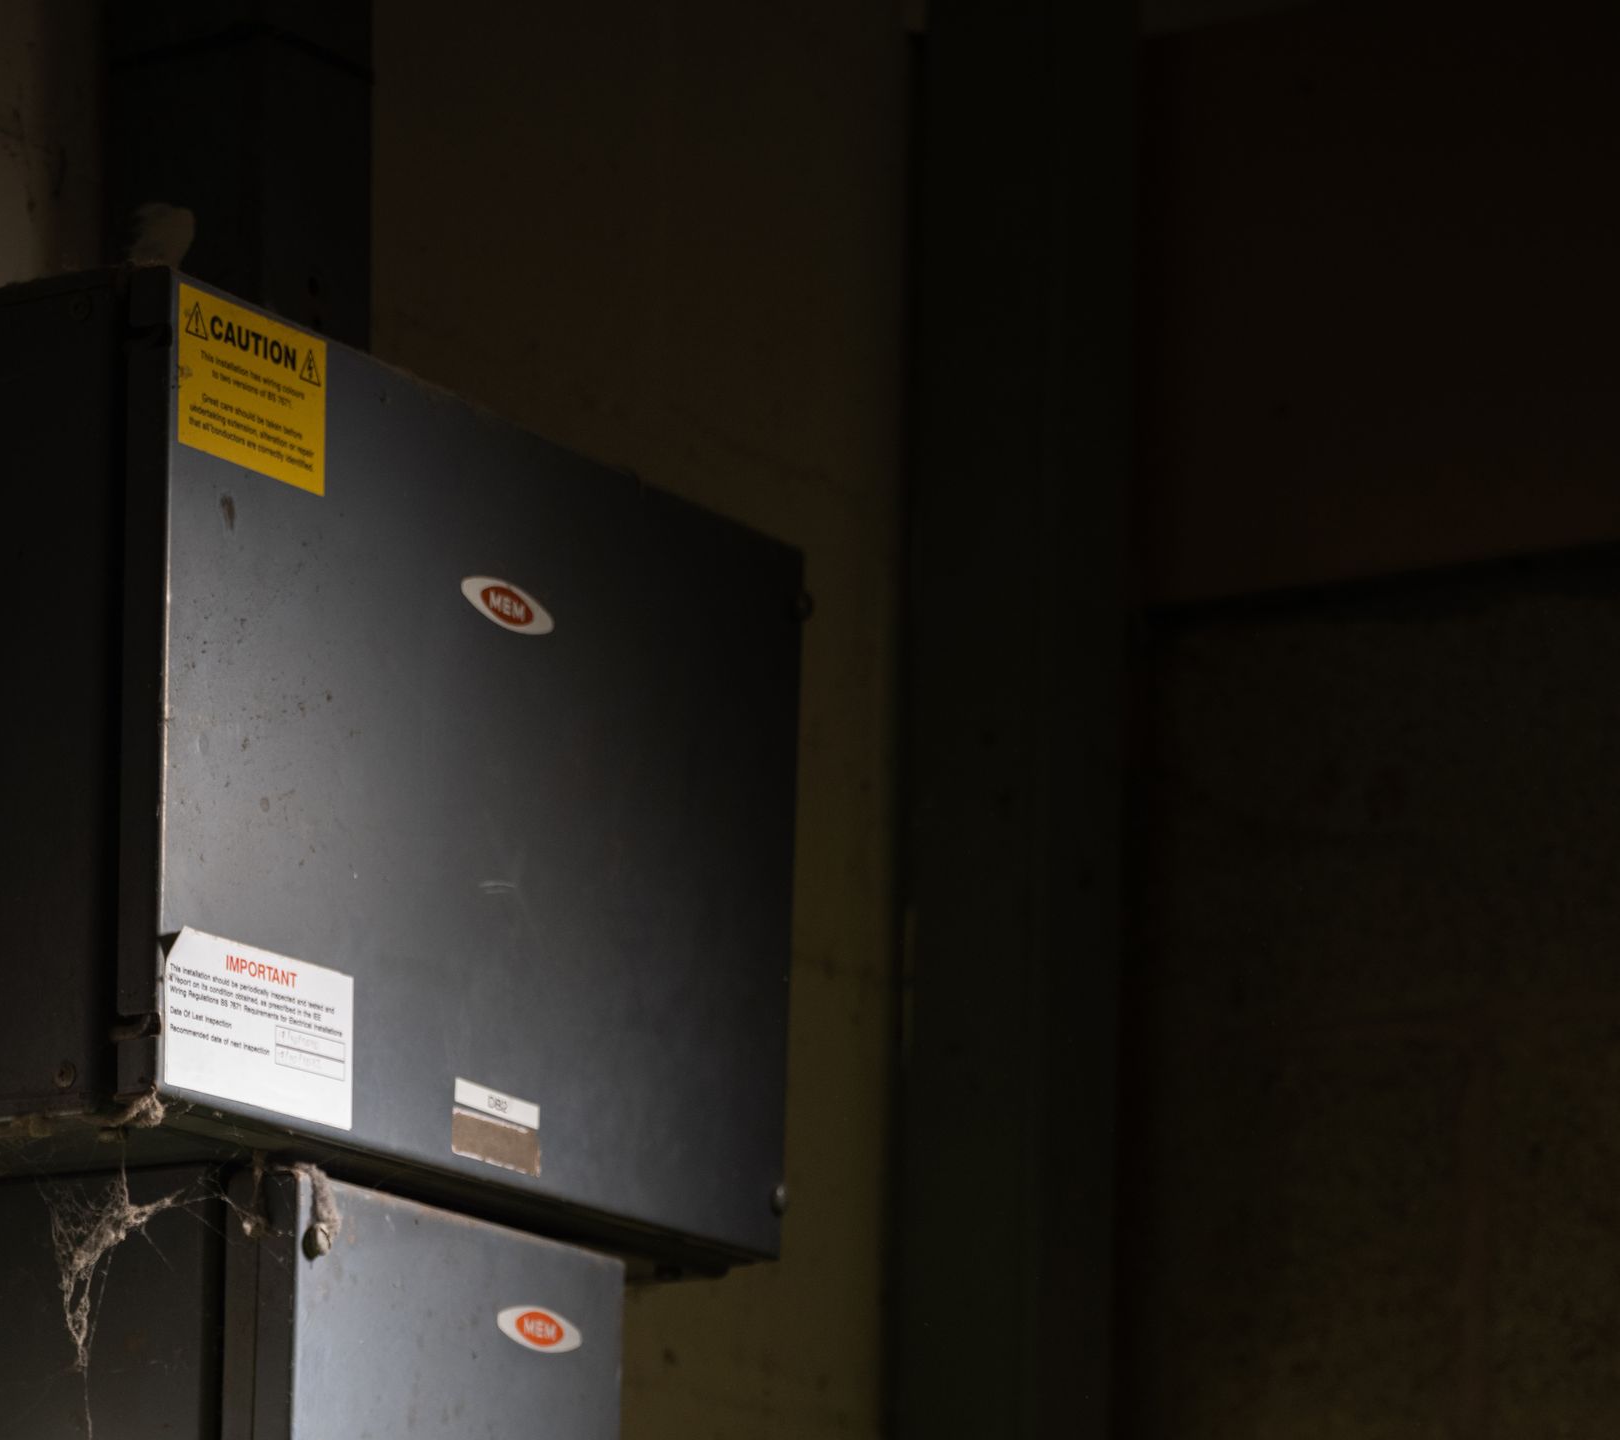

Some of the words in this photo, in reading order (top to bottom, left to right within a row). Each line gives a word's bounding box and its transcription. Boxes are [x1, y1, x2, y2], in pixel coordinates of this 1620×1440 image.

[210, 316, 297, 372] CAUTION
[488, 590, 526, 622] MEM
[225, 954, 297, 989] IMPORTANT
[170, 963, 181, 973] This
[183, 967, 211, 981] installation
[212, 976, 230, 987] should
[231, 980, 238, 988] be
[239, 983, 269, 998] periodically
[270, 989, 296, 1004] inspected
[297, 998, 307, 1008] and
[308, 1001, 324, 1013] tested
[325, 1006, 335, 1015] and
[170, 1006, 182, 1017] Date
[183, 1009, 191, 1018] Of
[192, 1011, 204, 1021] Last
[170, 1023, 210, 1040] Recommended
[211, 1034, 222, 1045] date
[230, 1040, 242, 1049] next
[523, 1318, 557, 1342] MEM
